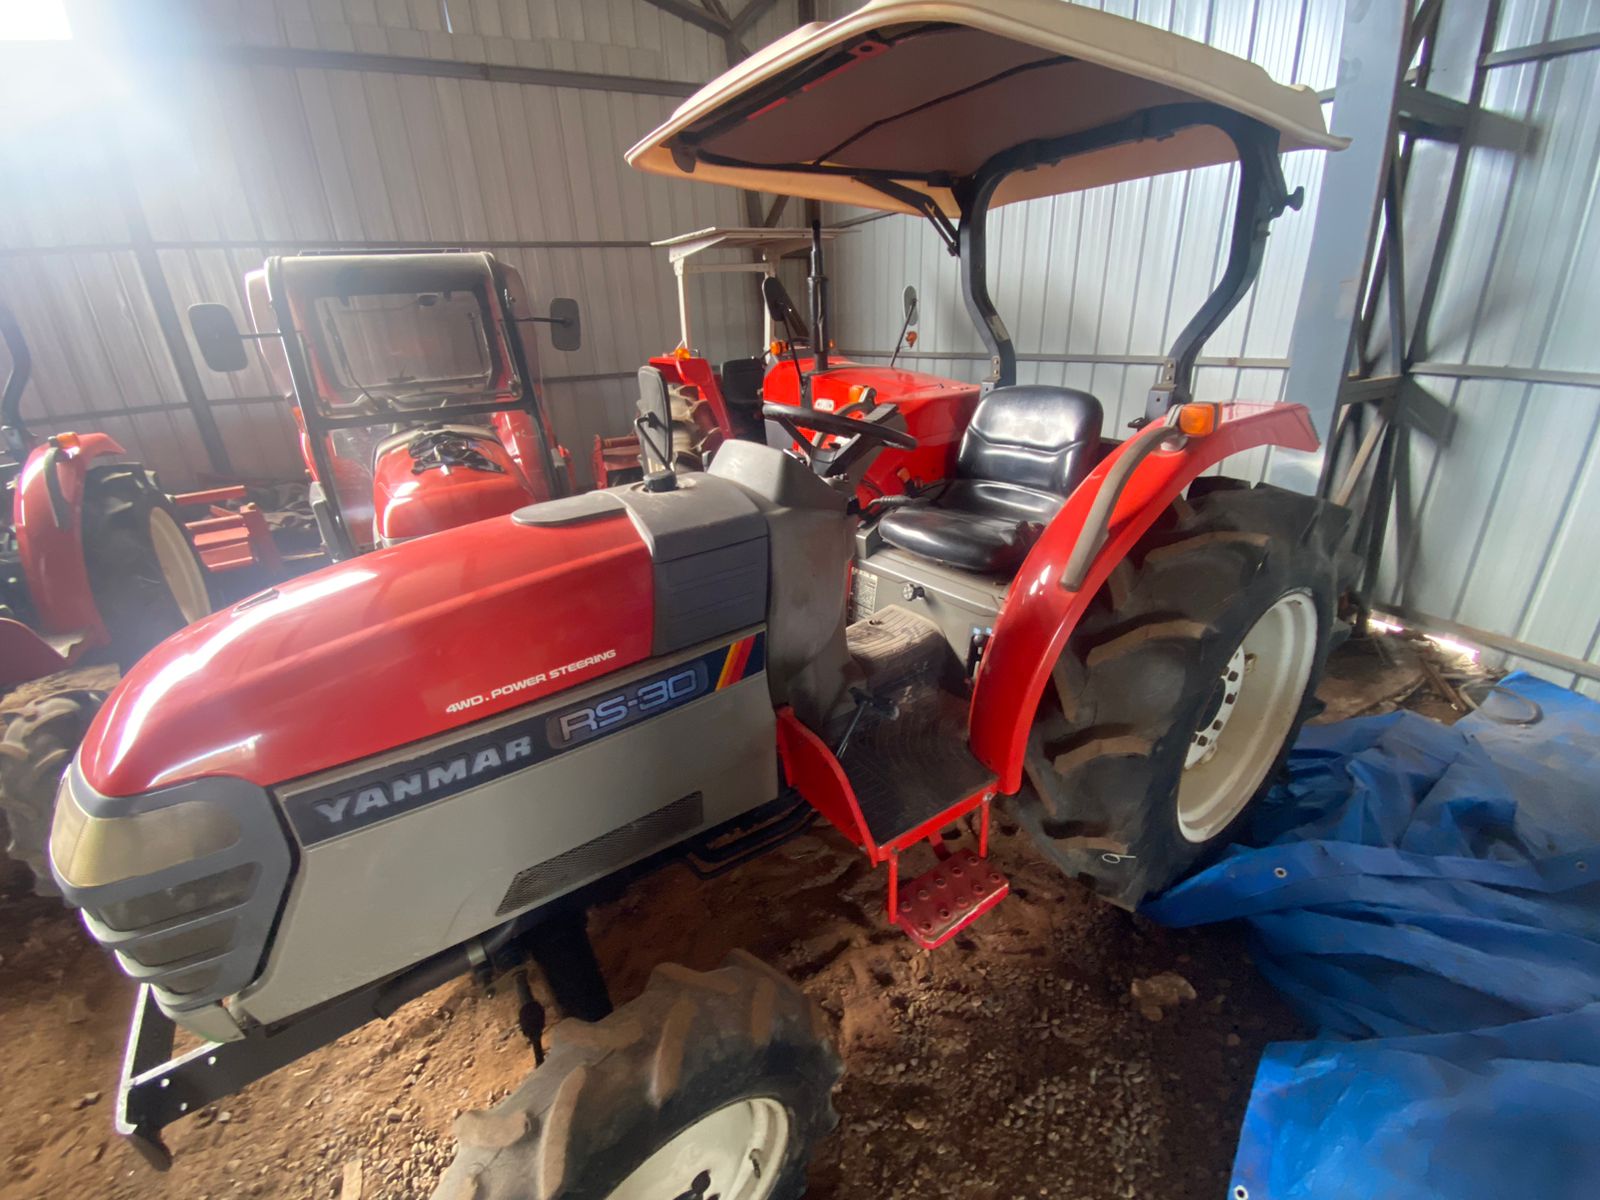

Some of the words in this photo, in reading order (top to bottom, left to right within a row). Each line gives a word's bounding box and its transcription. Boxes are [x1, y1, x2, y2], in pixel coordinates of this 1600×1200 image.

[491, 673, 547, 699] POWER
[549, 649, 617, 679] STEERING
[314, 735, 532, 824] YANMAR
[559, 668, 697, 742] RS-30
